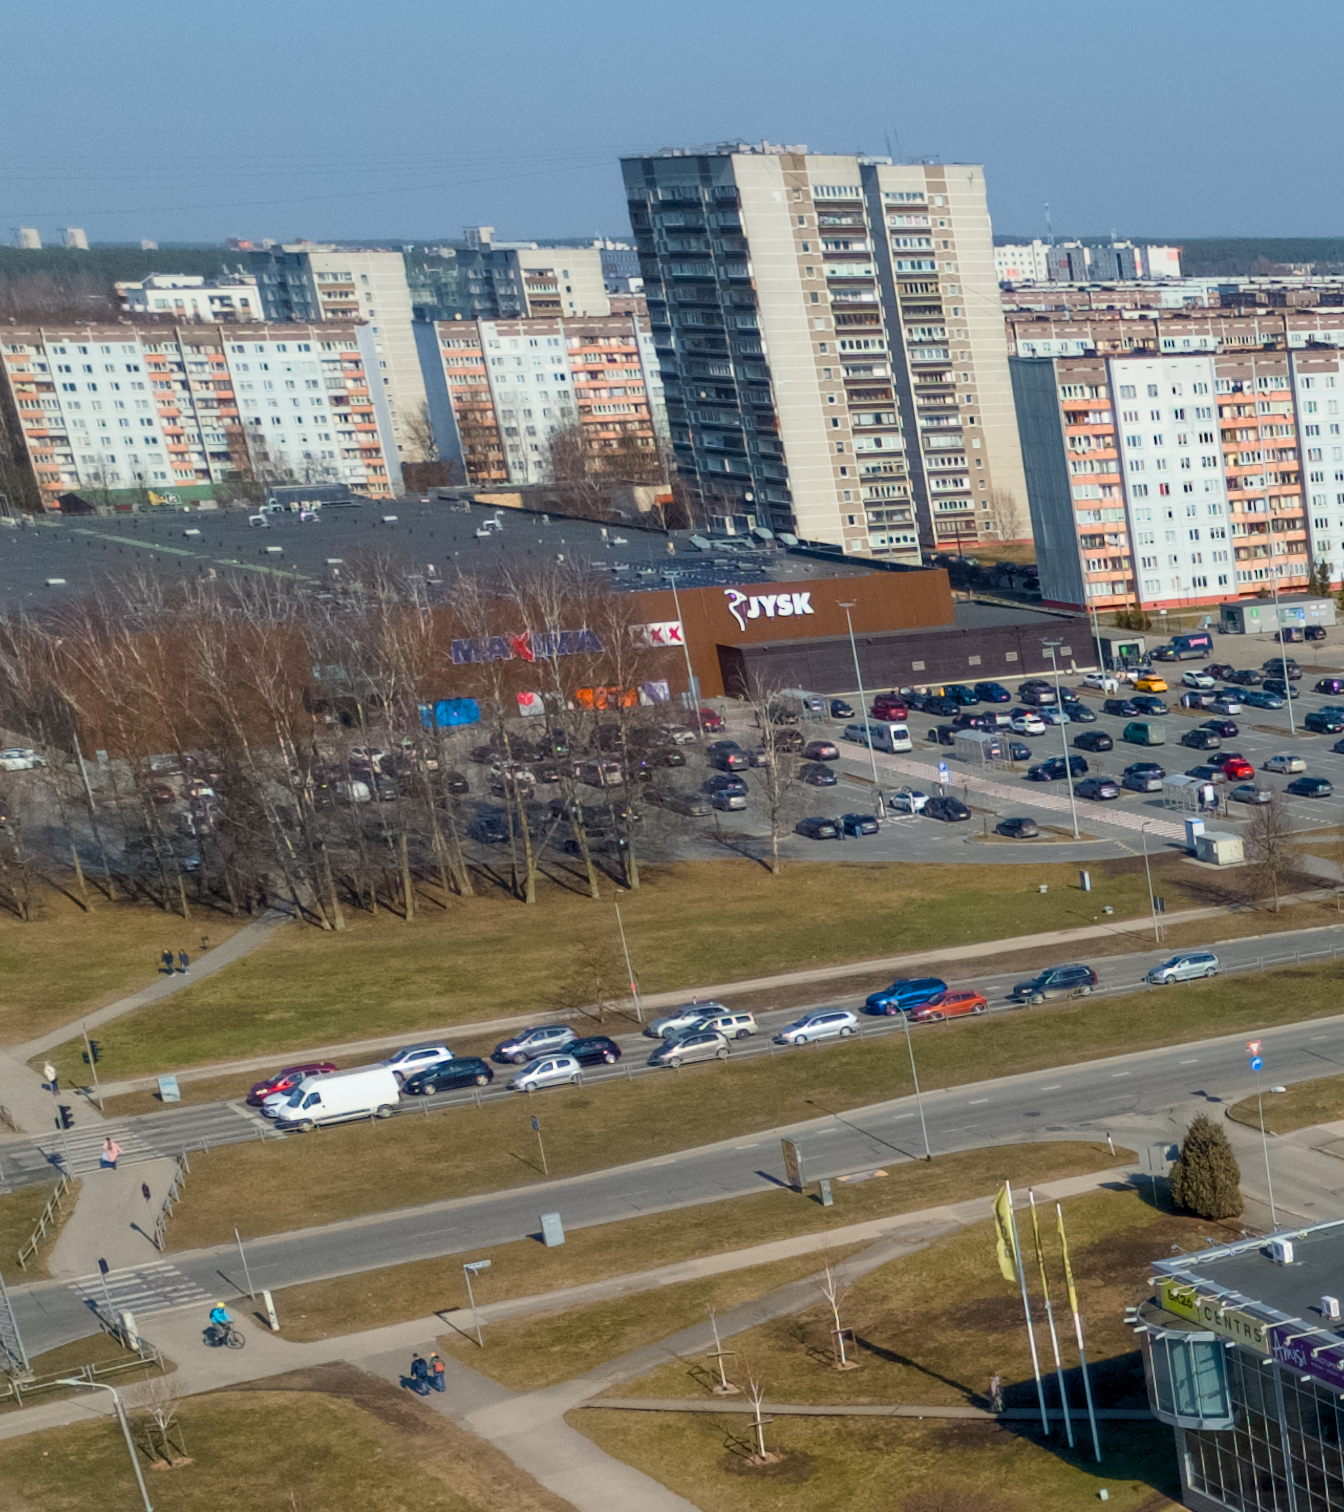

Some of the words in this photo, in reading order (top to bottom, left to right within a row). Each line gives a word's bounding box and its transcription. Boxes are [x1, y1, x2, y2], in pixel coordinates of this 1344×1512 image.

[746, 592, 814, 620] JYSK
[1204, 1306, 1262, 1343] CENTRS
[1272, 1329, 1307, 1367] Amisi
